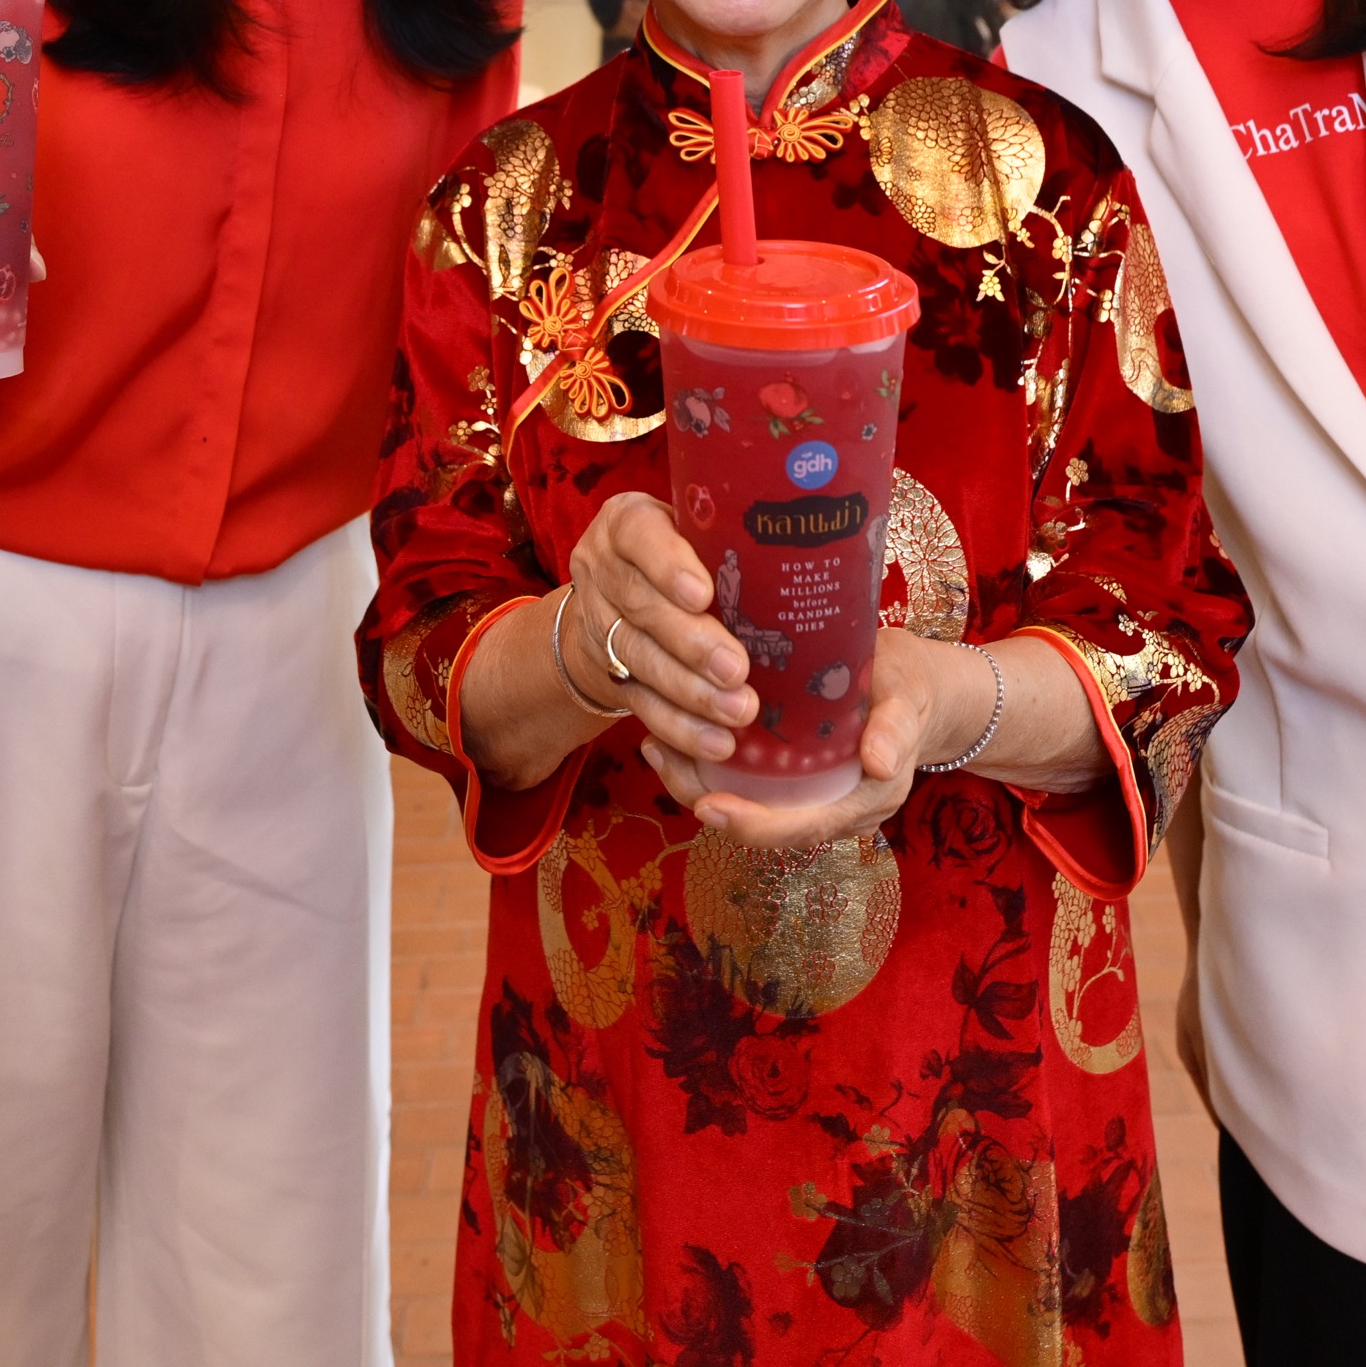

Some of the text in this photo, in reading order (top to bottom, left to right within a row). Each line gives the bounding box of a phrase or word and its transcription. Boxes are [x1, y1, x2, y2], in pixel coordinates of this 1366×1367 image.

[794, 453, 832, 479] gdh
[757, 500, 861, 535] หลานม่า
[781, 557, 841, 572] HOW TO
[793, 571, 830, 584] MAKE
[780, 581, 840, 596] MILLIONS
[793, 598, 828, 608] before
[778, 606, 841, 621] GRANDMA
[796, 621, 825, 633] DIES
